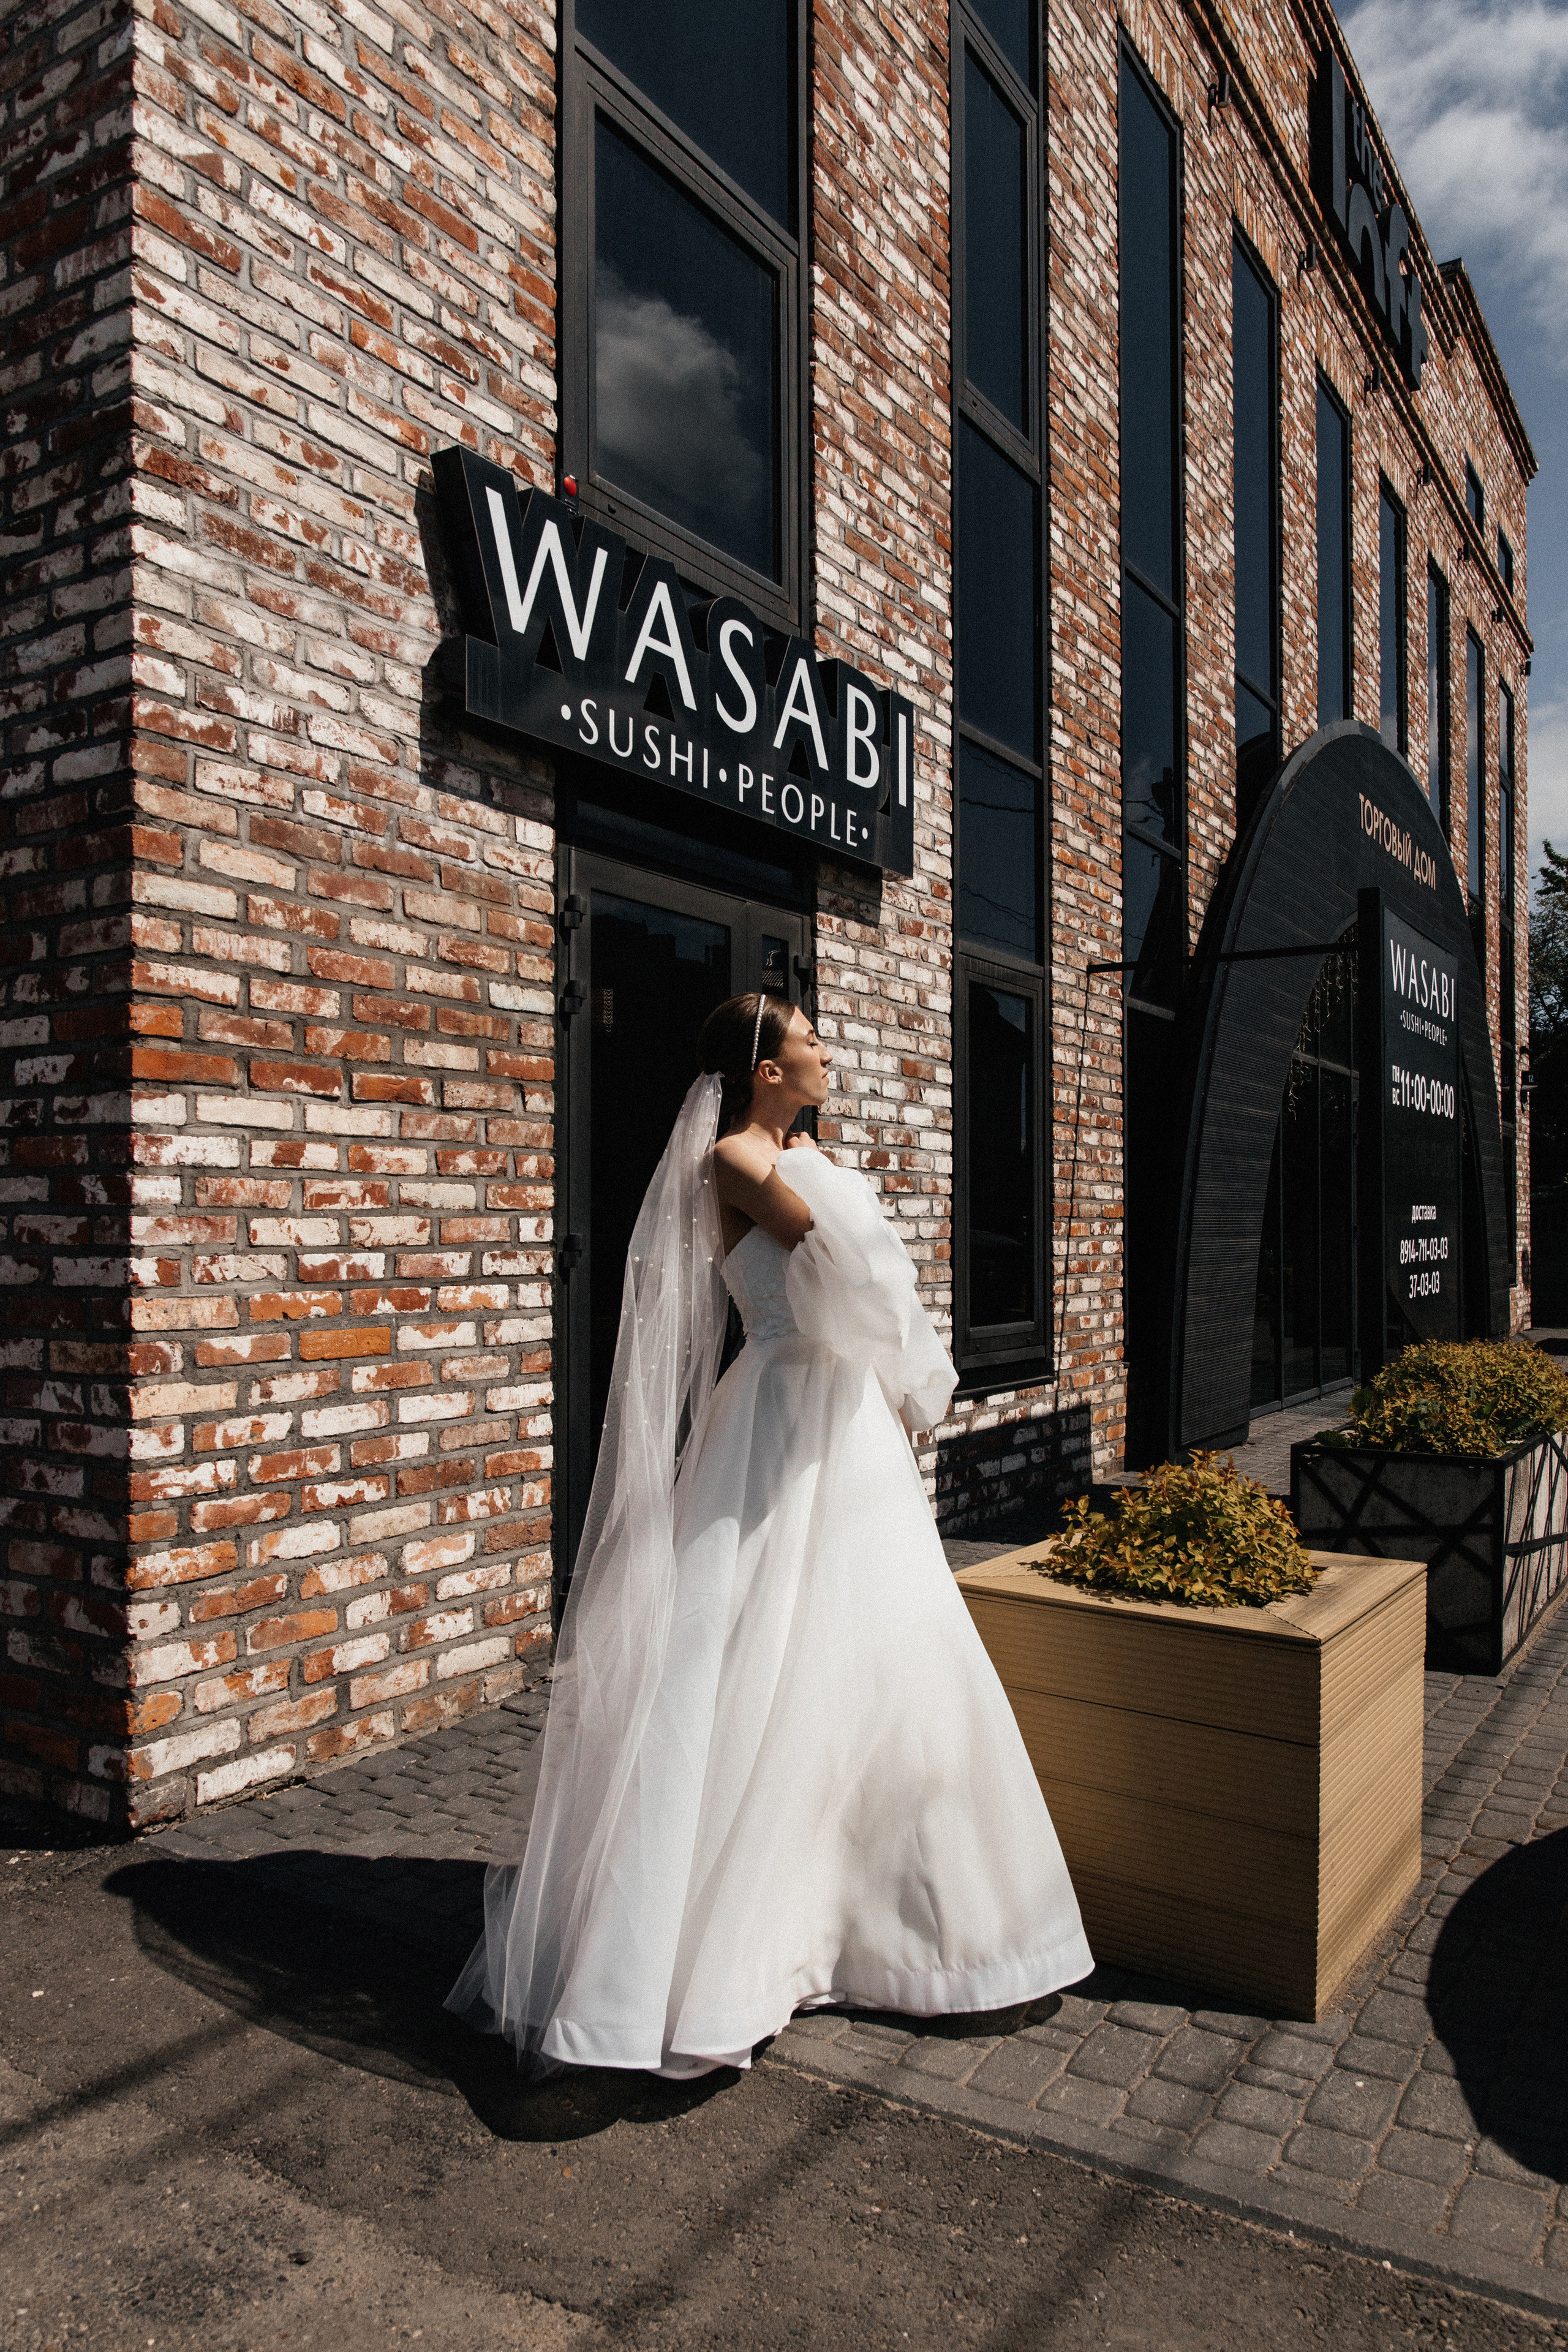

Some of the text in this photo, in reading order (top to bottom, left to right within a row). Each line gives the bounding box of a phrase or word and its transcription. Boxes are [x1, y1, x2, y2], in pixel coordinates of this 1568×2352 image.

[1352, 97, 1383, 214] the
[485, 486, 907, 808] WASABI
[1359, 793, 1436, 891] ТОРГОВЫЙ ДОМ
[1390, 939, 1455, 1022] WASABI
[1392, 1065, 1400, 1084] ПН
[1400, 1069, 1455, 1120] 11:00-00:00
[1392, 1087, 1400, 1106] ВС
[1411, 1205, 1436, 1224] доставка
[1400, 1237, 1448, 1264] 8914-711-03-03
[1409, 1270, 1440, 1299] 37-03-03
